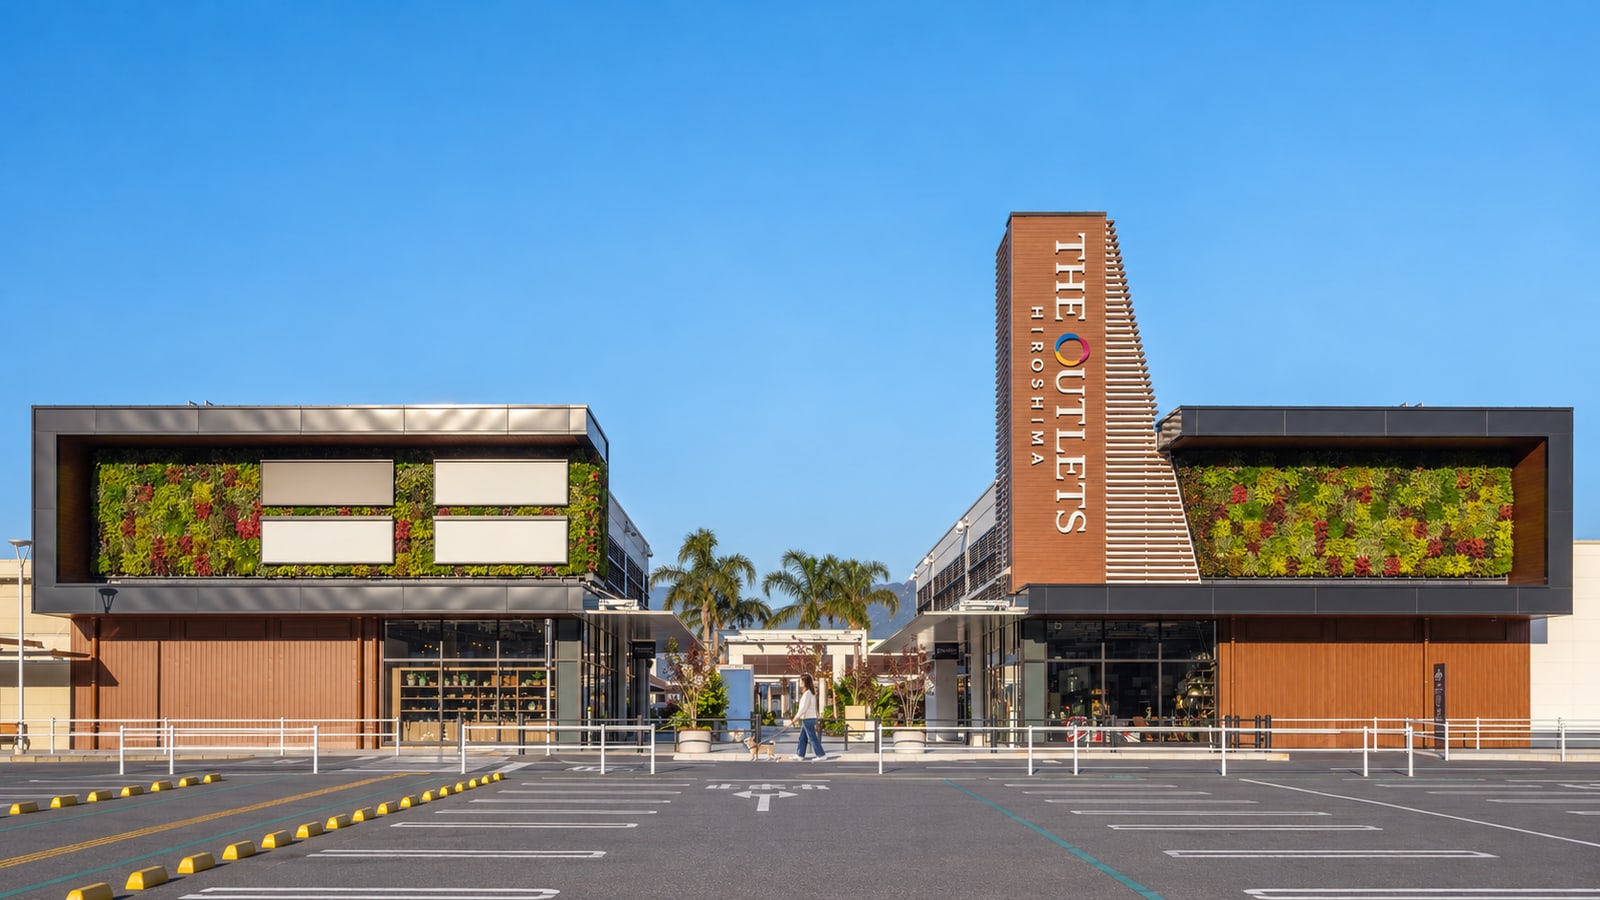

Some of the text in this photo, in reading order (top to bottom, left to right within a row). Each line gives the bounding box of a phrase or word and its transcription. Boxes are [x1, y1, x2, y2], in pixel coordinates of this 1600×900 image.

[1030, 305, 1045, 466] HIROSHIMA
[1055, 232, 1091, 534] THE OUTLETS
